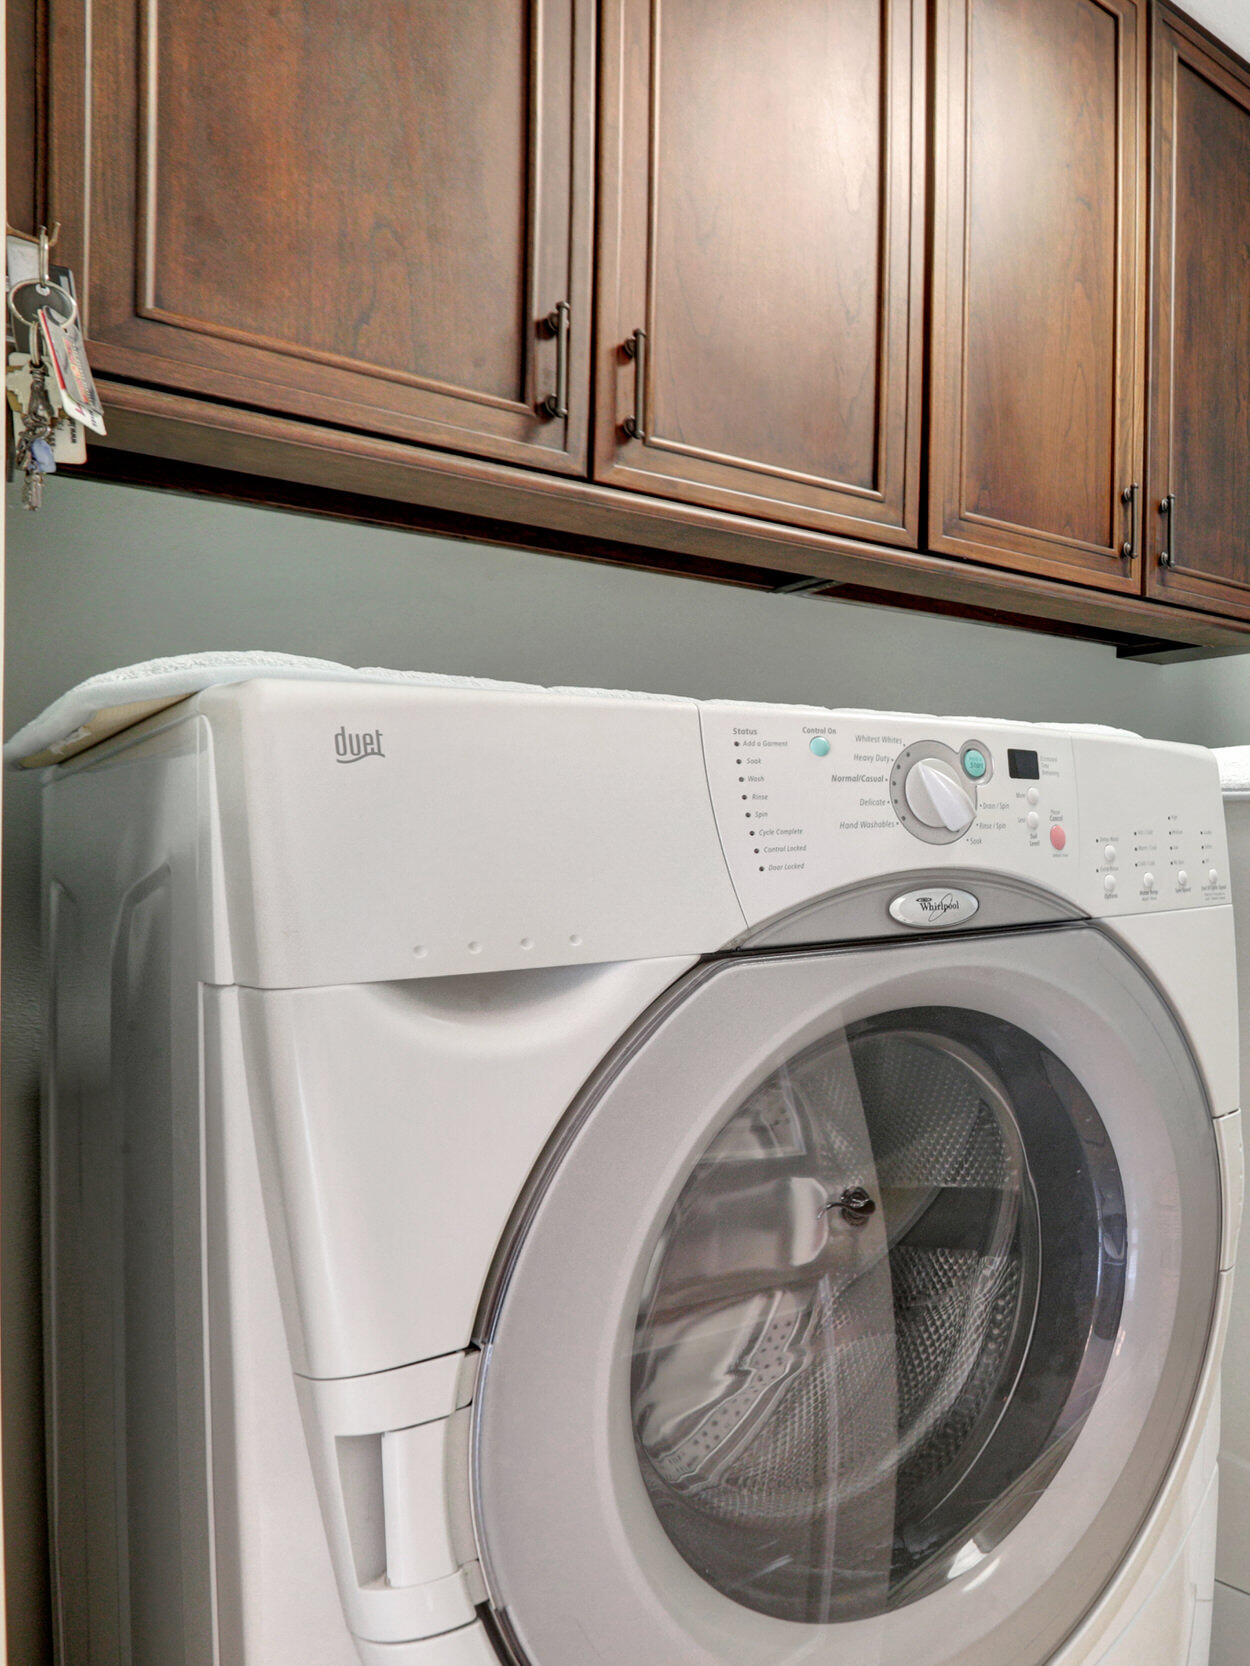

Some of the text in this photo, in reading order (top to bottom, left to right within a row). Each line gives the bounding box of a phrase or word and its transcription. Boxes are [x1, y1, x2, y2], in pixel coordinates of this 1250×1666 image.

[732, 727, 758, 735] Status
[802, 726, 826, 734] Control
[334, 726, 385, 758] duet
[746, 757, 762, 765] Soak
[854, 753, 890, 763] Heavy Duty
[831, 774, 884, 783] Normal/Casual
[859, 798, 886, 807] Delicate
[754, 811, 768, 819] Spin
[840, 820, 895, 830] Hand Washables
[759, 828, 803, 837] Cycle Complete
[786, 844, 807, 852] Locked
[784, 863, 805, 871] Locked
[919, 900, 960, 912] Whirlpool
